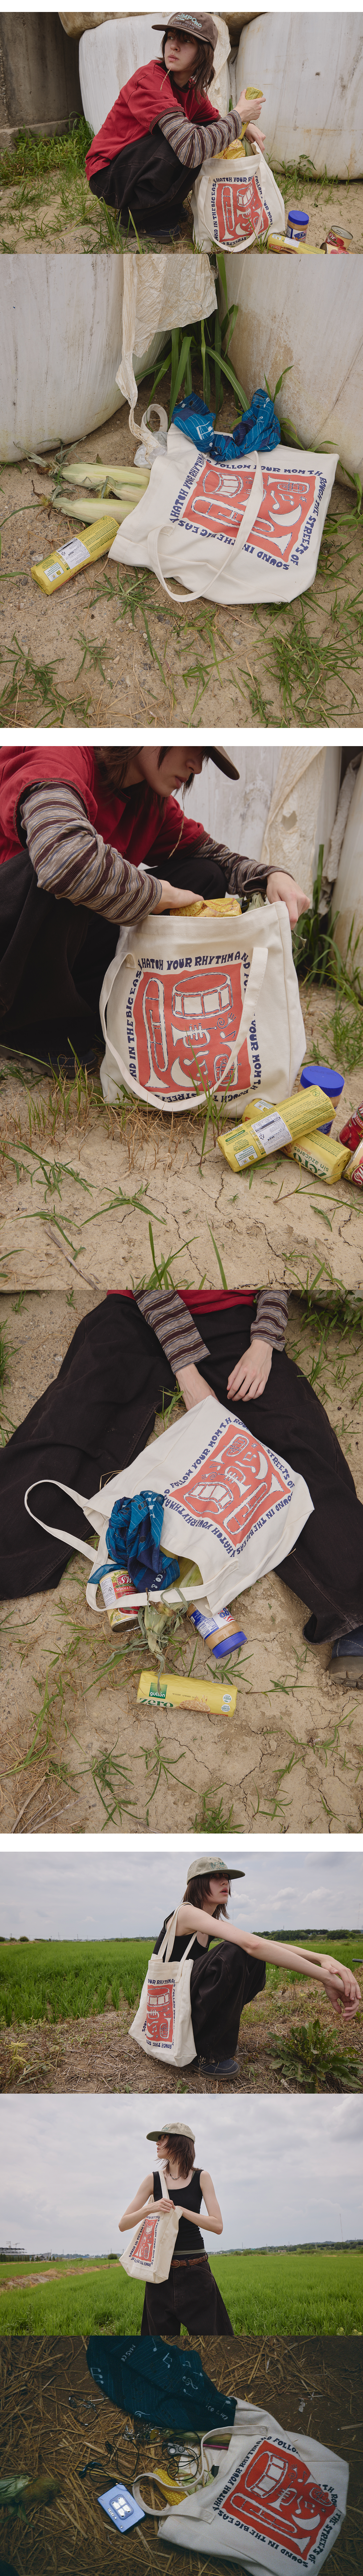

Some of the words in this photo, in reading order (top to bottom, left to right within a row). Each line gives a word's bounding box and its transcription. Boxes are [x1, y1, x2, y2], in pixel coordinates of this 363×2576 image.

[183, 475, 195, 490] YOUR
[200, 528, 218, 538] BIG
[295, 515, 316, 555] STREETS
[242, 544, 255, 554] IN
[257, 551, 290, 570] SOUND
[290, 554, 299, 566] OF
[166, 957, 192, 970] YOUR
[195, 952, 234, 966] RHYTHM
[249, 1019, 259, 1051] YOUR
[128, 1046, 136, 1060] IN
[252, 1054, 261, 1078] MOM
[294, 1147, 319, 1165] azúcares
[295, 1143, 311, 1155] añadidos
[293, 1153, 327, 1178] zero
[170, 1469, 193, 1488] FOLLOW
[191, 1448, 211, 1470] YOUR
[208, 1429, 223, 1448] MOM
[266, 1449, 290, 1480] STREETS
[287, 1480, 295, 1489] OF
[265, 1509, 275, 1519] IN
[253, 1517, 267, 1532] THE
[139, 1698, 174, 1708] zero
[228, 2468, 242, 2486] YOUR
[239, 2444, 259, 2468] RHYTHM
[234, 2520, 250, 2532] BIG
[329, 2513, 342, 2526] THE
[249, 2529, 266, 2542] THE
[313, 2523, 333, 2555] STREETS
[268, 2540, 280, 2550] IN
[281, 2548, 309, 2568] SOUND
[308, 2553, 316, 2564] OF
